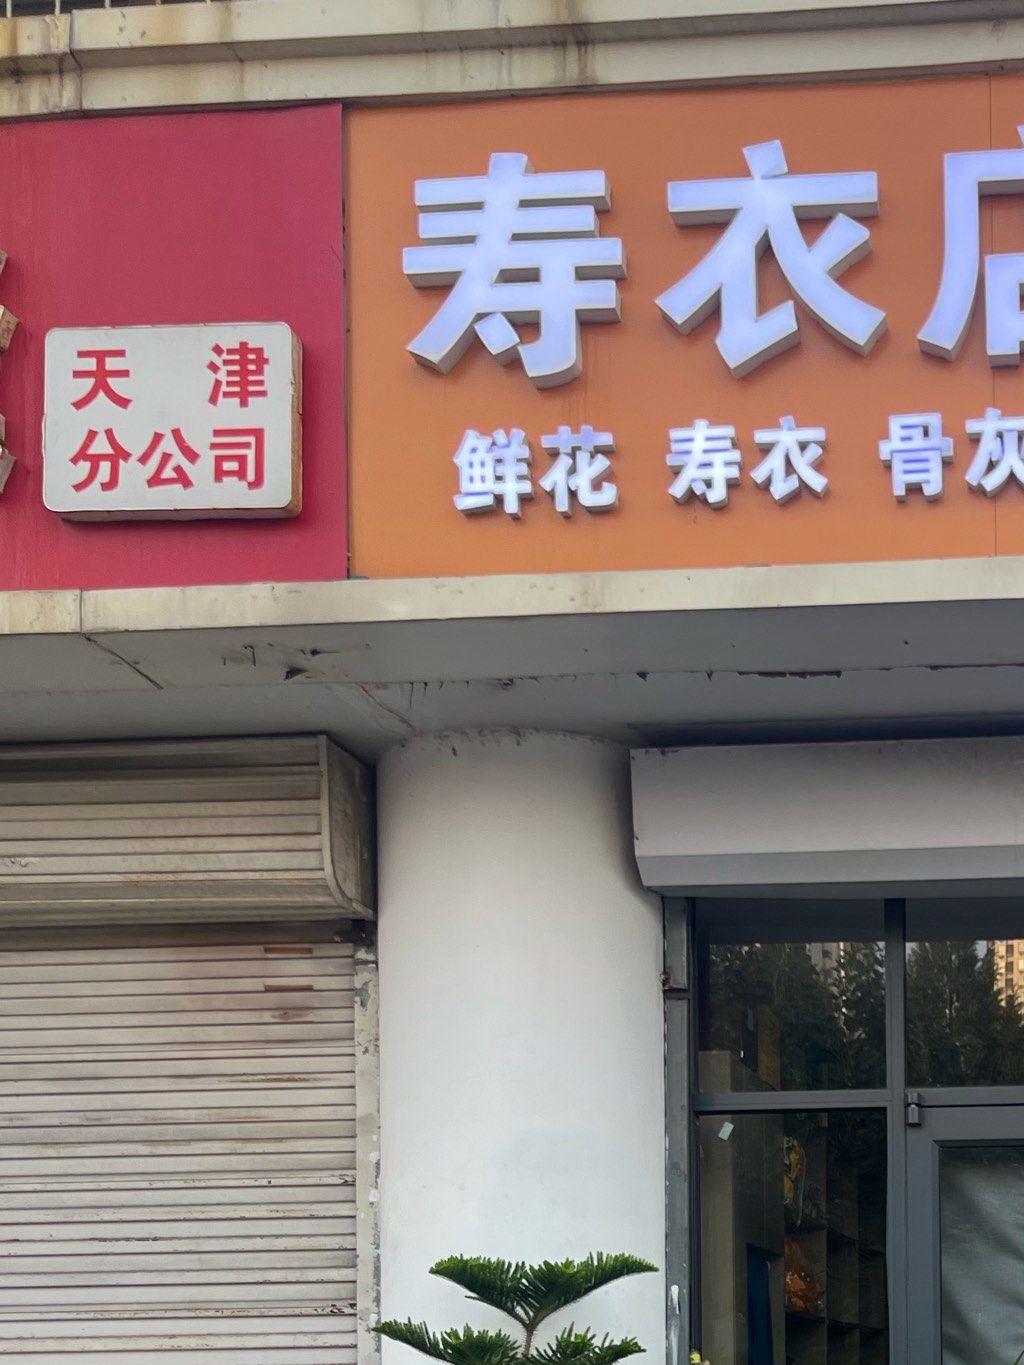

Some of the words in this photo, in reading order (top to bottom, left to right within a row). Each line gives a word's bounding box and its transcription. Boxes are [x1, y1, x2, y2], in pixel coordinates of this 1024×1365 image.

[70, 427, 269, 492] 分公司
[452, 424, 620, 519] 鲜花
[665, 415, 829, 510] 寿衣
